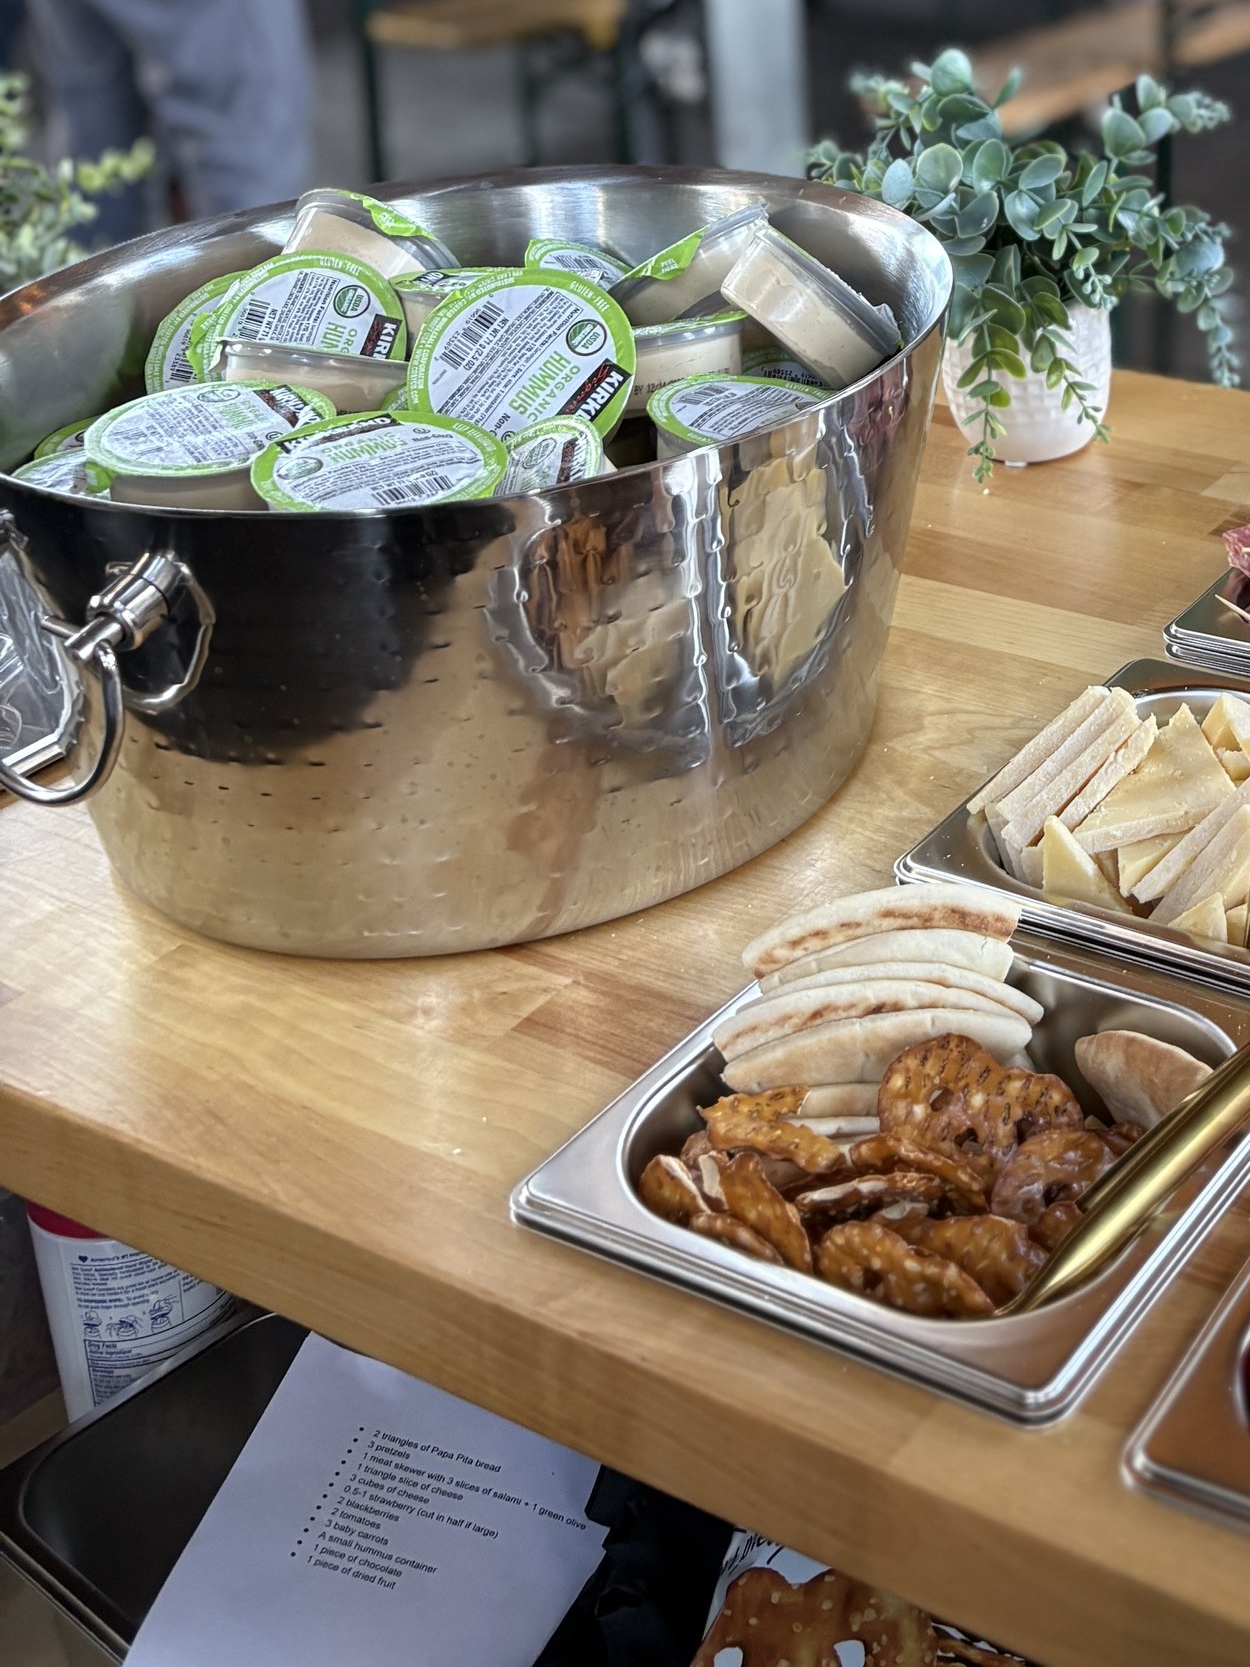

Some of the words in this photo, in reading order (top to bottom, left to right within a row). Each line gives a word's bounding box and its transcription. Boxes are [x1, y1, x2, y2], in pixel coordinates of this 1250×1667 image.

[270, 308, 279, 319] NET
[445, 298, 467, 318] COSTCO
[555, 306, 579, 331] Nutrition
[424, 315, 448, 349] WHOLESALE
[489, 327, 500, 338] WT
[496, 316, 509, 328] NET
[443, 330, 460, 350] 23389
[482, 336, 492, 345] 71
[538, 330, 557, 348] Facts:
[580, 330, 600, 350] USDA
[462, 358, 474, 370] OZ)
[470, 347, 483, 360] (2.5
[417, 348, 429, 389] CORPORATION
[508, 350, 570, 416] HUMMUS
[527, 364, 580, 422] ORGANIC
[573, 369, 624, 421] KIRKL
[328, 435, 408, 463] HUMMUS
[367, 1439, 375, 1448] 3
[374, 1444, 410, 1459] pretzels
[372, 1429, 381, 1437] 2
[381, 1432, 418, 1449] triangles
[419, 1444, 431, 1452] of
[430, 1445, 454, 1459] Papa
[455, 1453, 473, 1465] Pita
[474, 1458, 501, 1472] bread
[349, 1473, 357, 1482] 3
[357, 1477, 384, 1490] cubes
[396, 1489, 429, 1504] cheese
[357, 1462, 362, 1470] 1
[363, 1464, 396, 1481] triangle
[397, 1476, 418, 1487] slice
[430, 1486, 463, 1500] cheese
[363, 1451, 368, 1459] 1
[369, 1455, 393, 1467] meat
[393, 1462, 426, 1476] skewer
[427, 1472, 445, 1483] with
[446, 1476, 454, 1485] 3
[454, 1479, 480, 1492] slices
[481, 1487, 493, 1495] of
[491, 1491, 522, 1505] salami
[537, 1506, 564, 1522] green
[565, 1517, 586, 1531] olive
[330, 1507, 339, 1515] 2
[339, 1510, 381, 1529] tomatoes
[336, 1495, 345, 1505] 2
[345, 1498, 399, 1521] blackberries
[343, 1484, 367, 1498] 0.5-1
[368, 1493, 416, 1514] strawberry
[416, 1507, 435, 1519] (cut
[435, 1513, 445, 1522] in
[445, 1515, 465, 1527] half
[464, 1520, 472, 1529] if
[471, 1522, 498, 1539] large)
[324, 1518, 332, 1527] 3
[332, 1521, 356, 1536] baby
[357, 1530, 388, 1545] carrots
[313, 1543, 319, 1551] 1
[318, 1546, 345, 1559] piece
[346, 1554, 358, 1563] of
[358, 1558, 402, 1577] chocolate
[317, 1531, 326, 1540] A
[327, 1534, 354, 1547] small
[355, 1543, 393, 1560] hummus
[394, 1556, 437, 1573] container
[307, 1555, 313, 1563] 1
[312, 1558, 339, 1571] piece
[340, 1566, 352, 1575] of
[351, 1570, 377, 1583] dried
[376, 1576, 396, 1589] fruit
